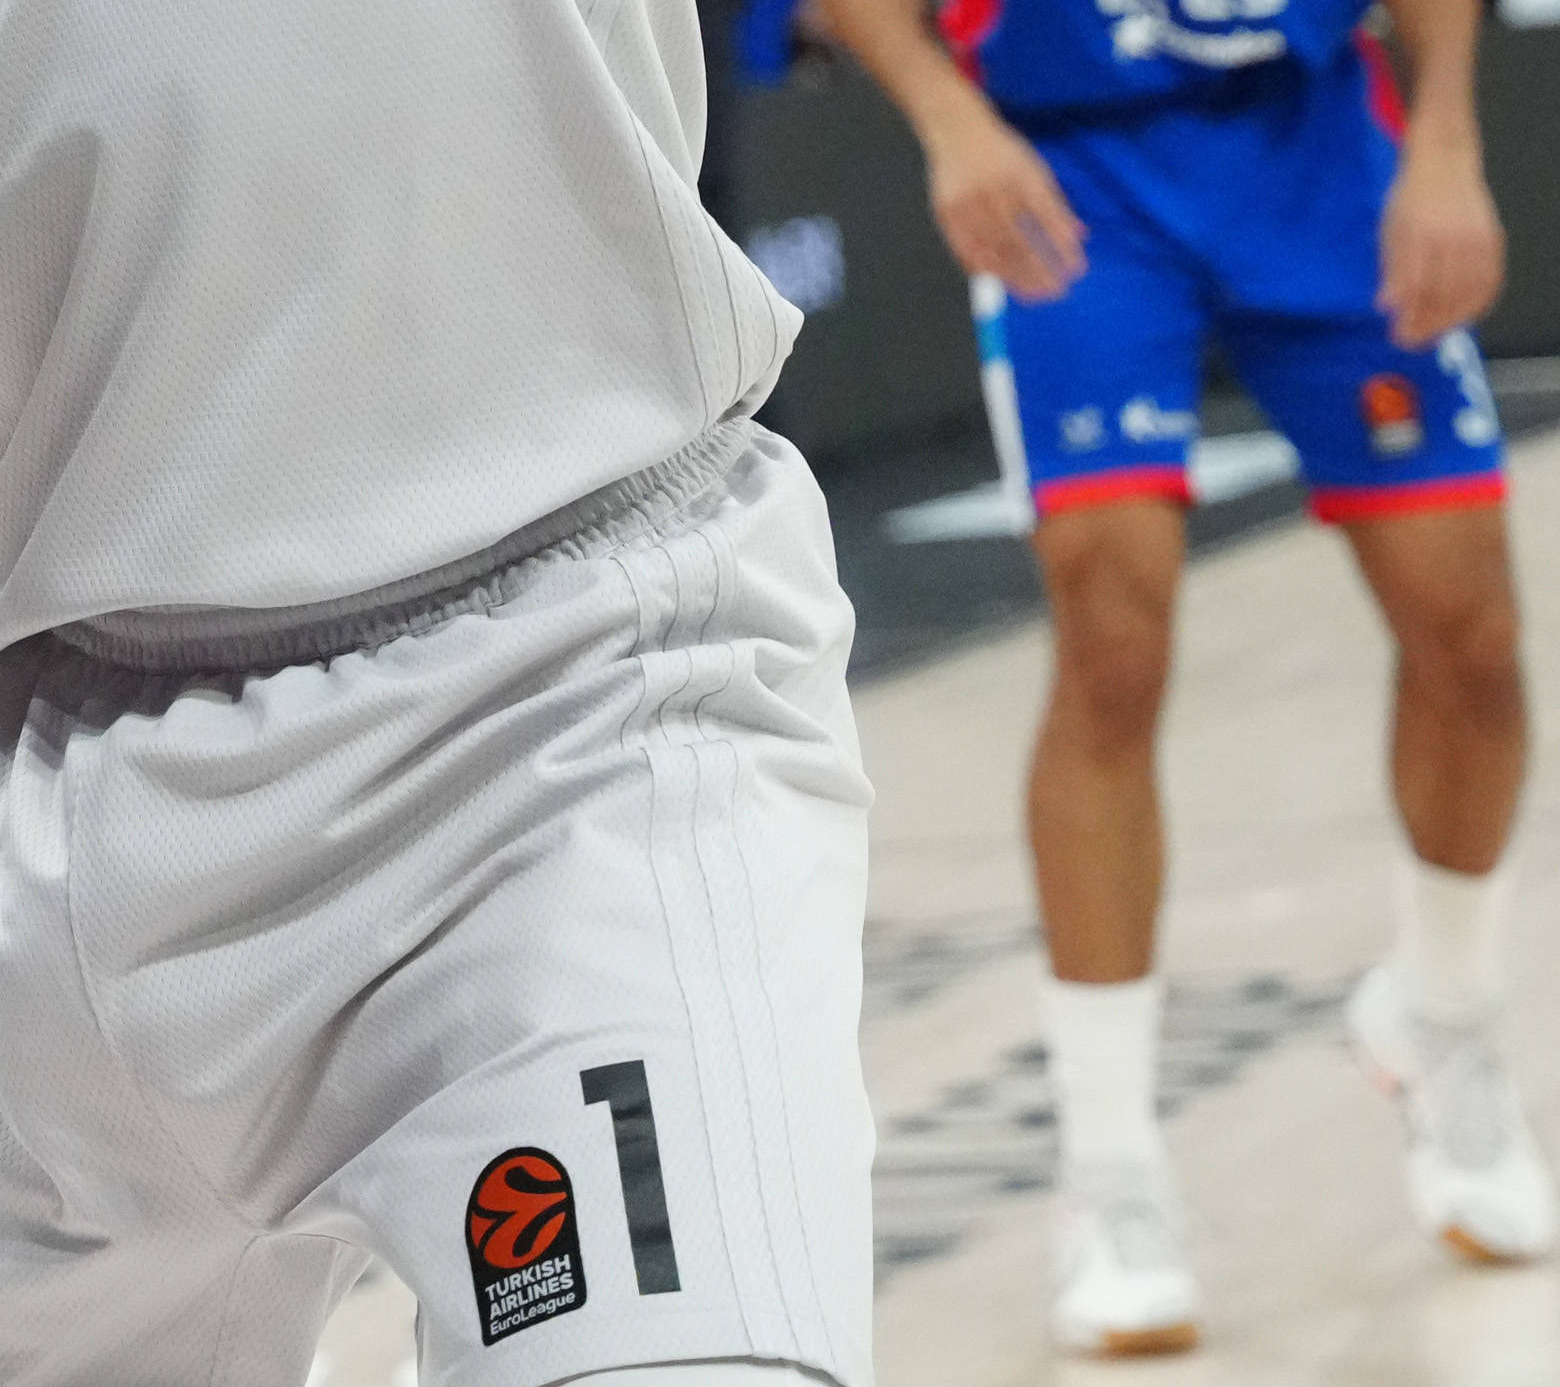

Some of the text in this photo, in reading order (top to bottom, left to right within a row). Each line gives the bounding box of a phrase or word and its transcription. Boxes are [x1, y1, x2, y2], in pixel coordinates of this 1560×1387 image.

[579, 1059, 683, 1296] 1
[484, 1254, 571, 1301] TURKISH
[490, 1272, 574, 1320] AIRLINES
[489, 1292, 576, 1336] EuroLeague
